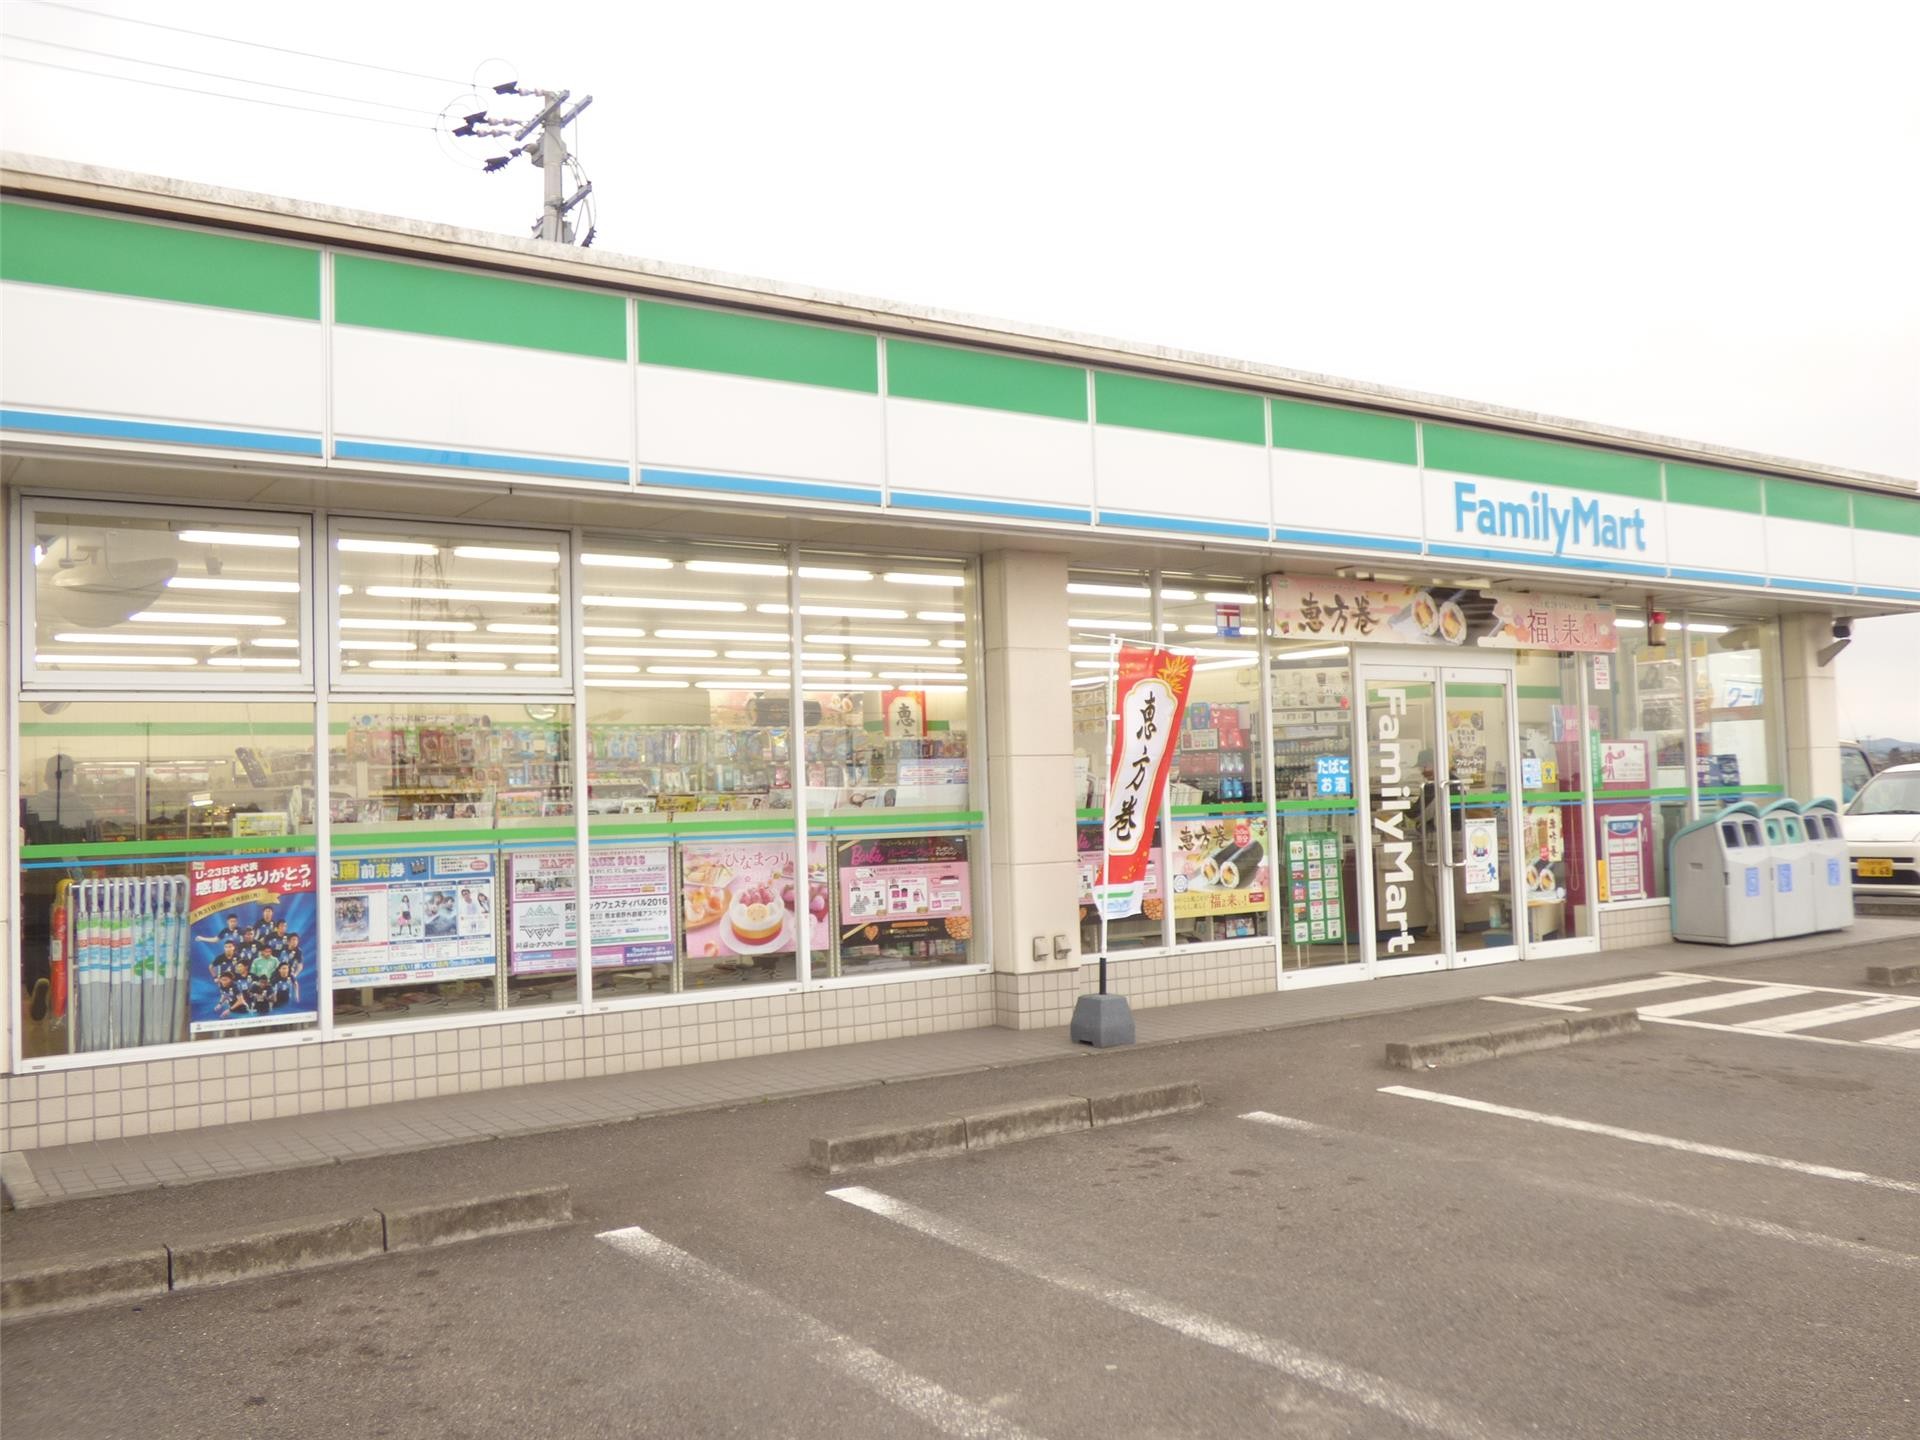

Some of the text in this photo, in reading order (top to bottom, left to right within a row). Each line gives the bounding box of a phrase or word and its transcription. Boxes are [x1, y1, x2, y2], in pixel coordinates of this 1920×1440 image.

[1454, 481, 1646, 557] FamilyMart
[1298, 592, 1379, 636] 恵方巻
[1109, 690, 1159, 841] 恵方巻
[1318, 759, 1349, 774] たばこ
[1321, 777, 1347, 792] お酒
[1374, 687, 1416, 953] FamilyMart
[1178, 822, 1230, 851] 恵方巻
[195, 862, 259, 880] U-23日本代表
[725, 852, 790, 869] ひなまつり
[196, 864, 311, 896] 感動をありがとう
[282, 879, 312, 891] セール
